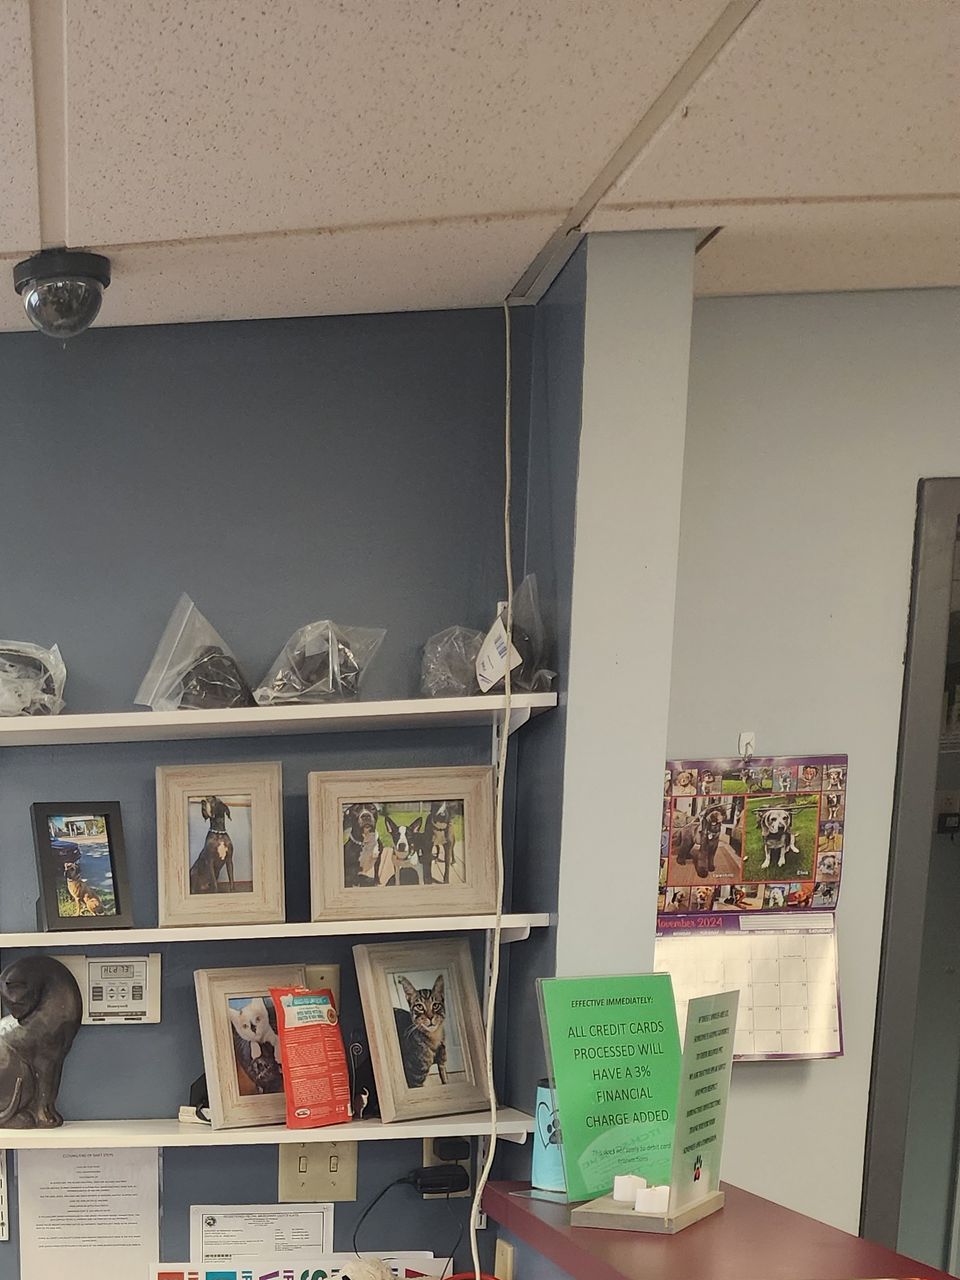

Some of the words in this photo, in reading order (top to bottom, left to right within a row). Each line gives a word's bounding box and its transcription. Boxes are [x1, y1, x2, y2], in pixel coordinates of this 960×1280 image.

[698, 917, 723, 928] 2024
[571, 999, 605, 1008] EFFECTIVE
[606, 996, 653, 1006] IMMEDIATELY:
[567, 1026, 587, 1039] ALL
[589, 1022, 627, 1037] CREDIT
[629, 1020, 664, 1034] CARDS
[574, 1045, 635, 1060] PROCESSED
[638, 1042, 664, 1055] WILL
[593, 1067, 621, 1081] HAVE
[625, 1066, 633, 1079] A
[635, 1065, 651, 1078] 3%
[596, 1087, 653, 1103] FINANCIAL
[586, 1113, 630, 1128] CHARGE
[632, 1109, 669, 1123] ADDED
